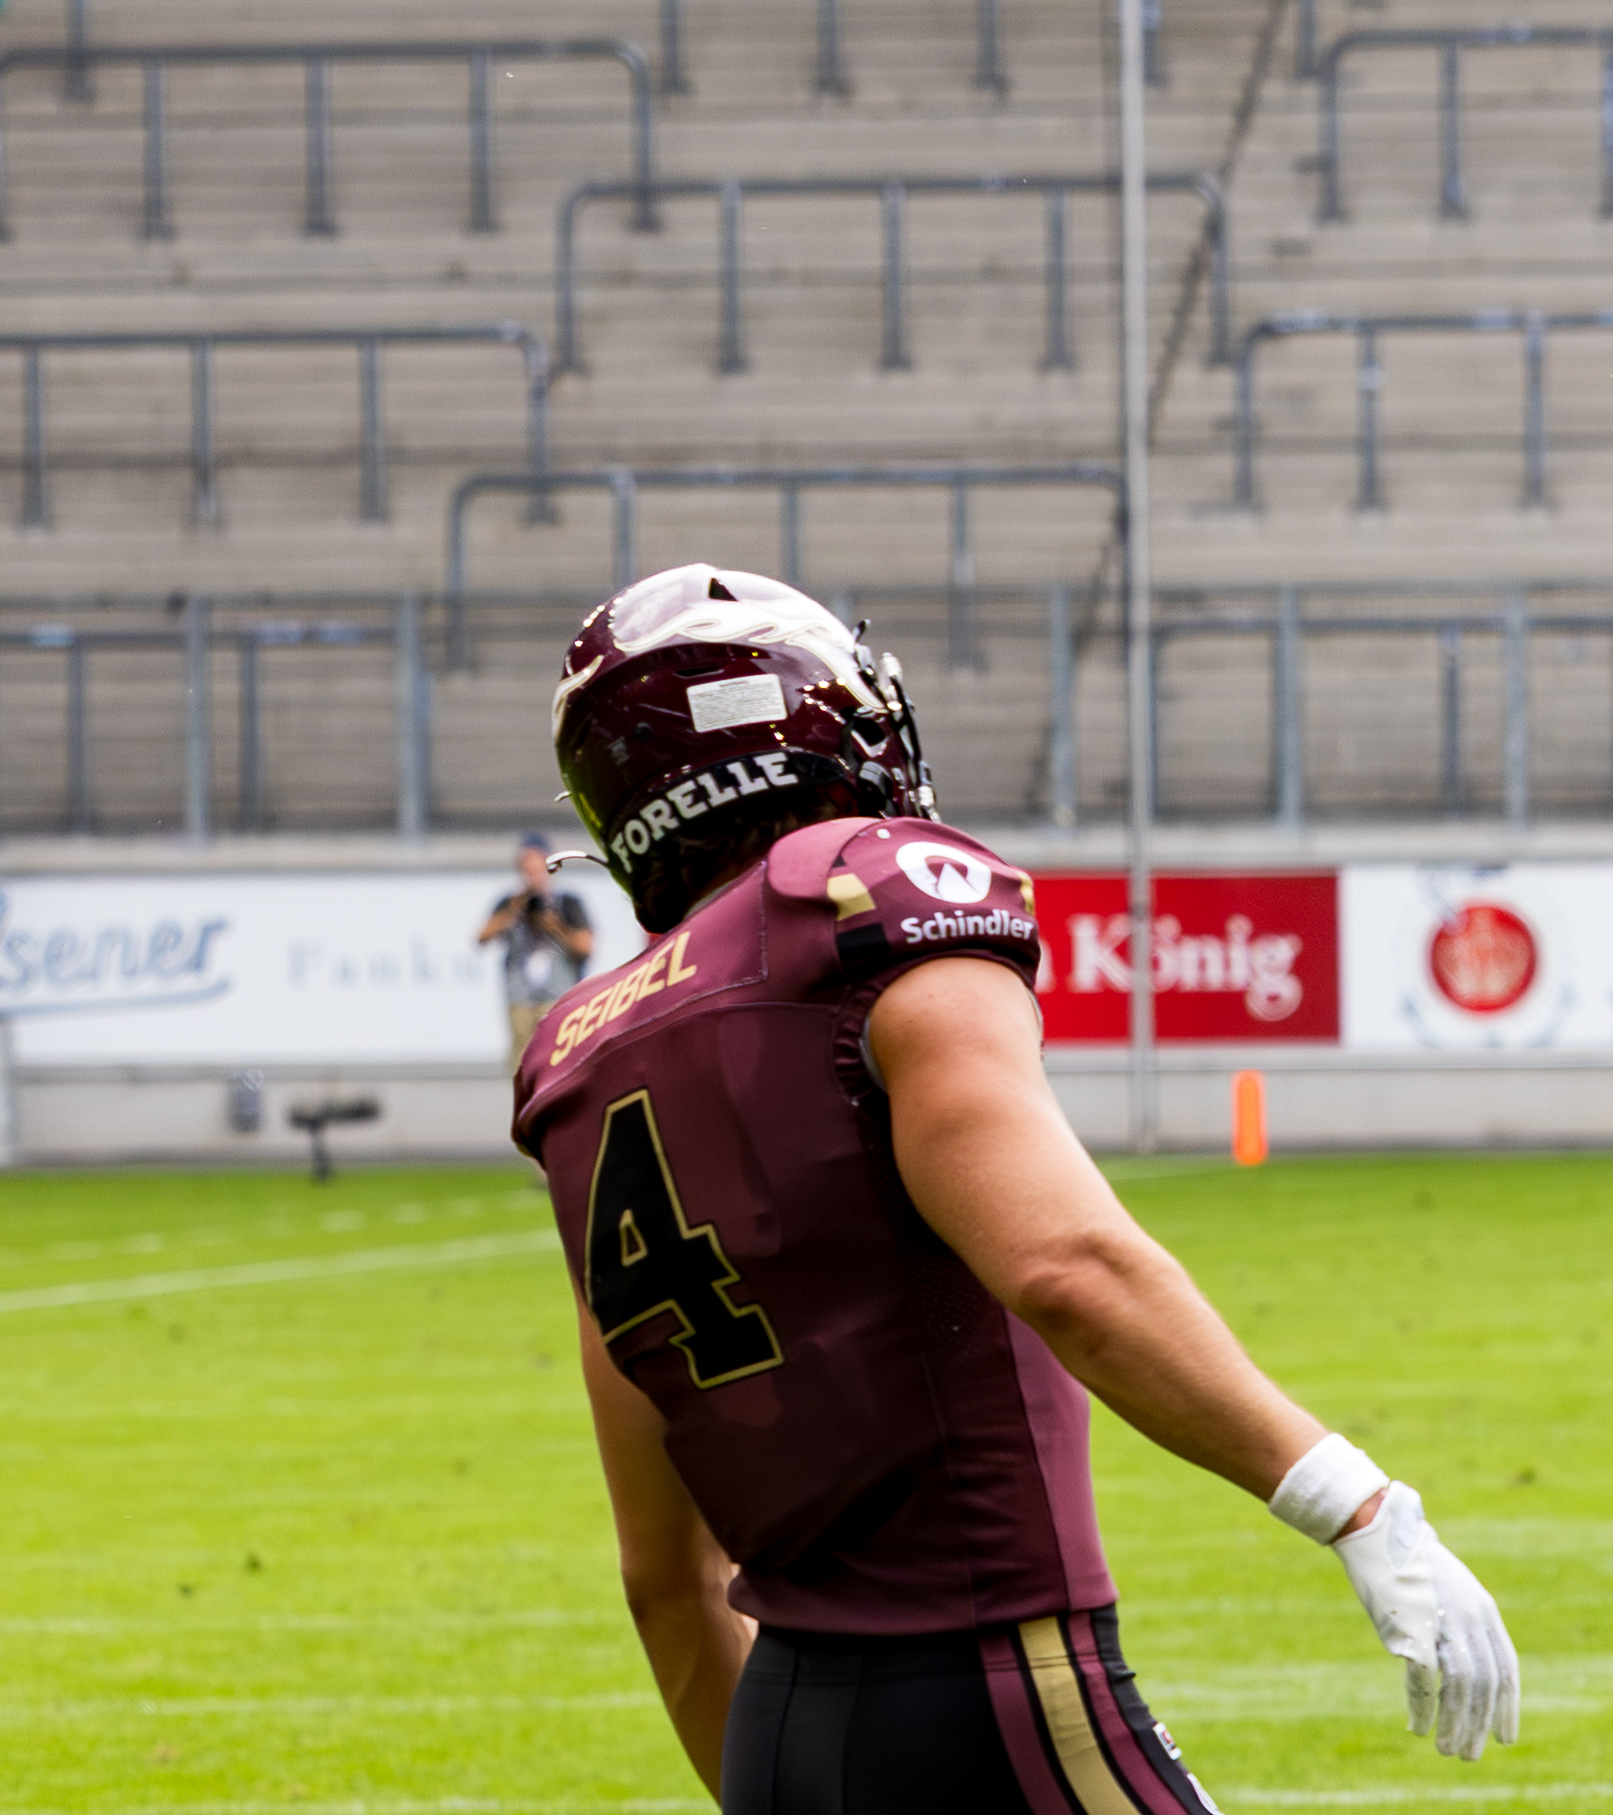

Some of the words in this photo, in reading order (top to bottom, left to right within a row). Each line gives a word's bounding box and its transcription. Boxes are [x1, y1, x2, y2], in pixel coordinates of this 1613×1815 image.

[610, 753, 798, 873] FORELLE
[0, 888, 228, 990] sener
[901, 909, 1034, 945] Schindler
[550, 932, 697, 1066] SEIBEL
[585, 1088, 785, 1390] 4
